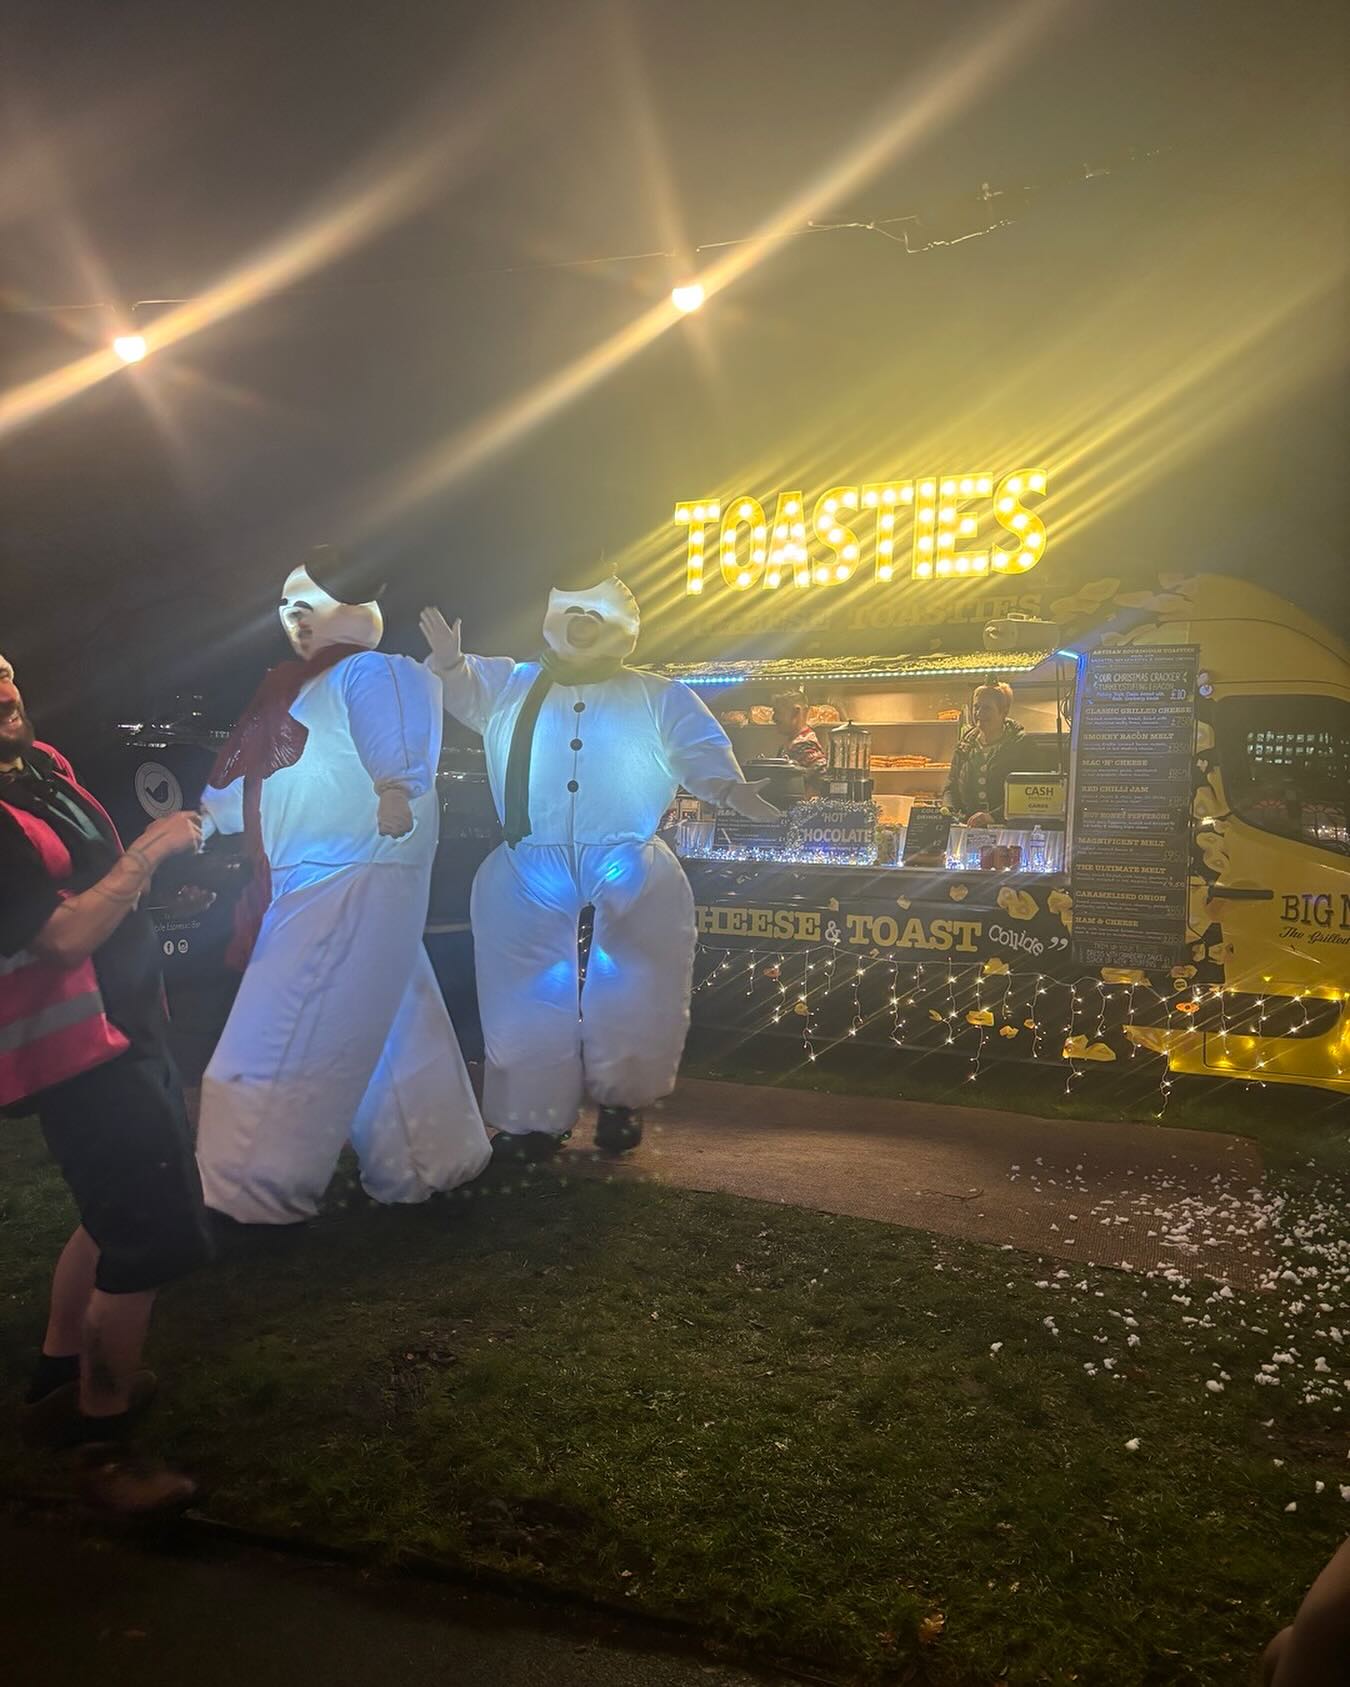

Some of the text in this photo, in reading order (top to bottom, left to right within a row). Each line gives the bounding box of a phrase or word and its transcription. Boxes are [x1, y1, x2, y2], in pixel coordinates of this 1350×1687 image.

[674, 469, 1048, 596] TOASTIES
[1113, 671, 1149, 682] CHRISTMAS
[1085, 707, 1119, 715] CLASSIC
[1119, 732, 1149, 740] BACON
[1024, 786, 1054, 796] CASH
[1077, 837, 1139, 846] MAGNIFICENT
[1095, 865, 1140, 873] ULTIMATE
[1140, 866, 1167, 874] MELT
[1075, 891, 1167, 902] CARAMELISED ONION
[1280, 893, 1334, 928] BIG
[695, 905, 821, 940] HEESE
[824, 920, 842, 946] &
[846, 913, 983, 951] TOAST
[1105, 919, 1139, 927] CHEESE
[1279, 926, 1305, 938] The
